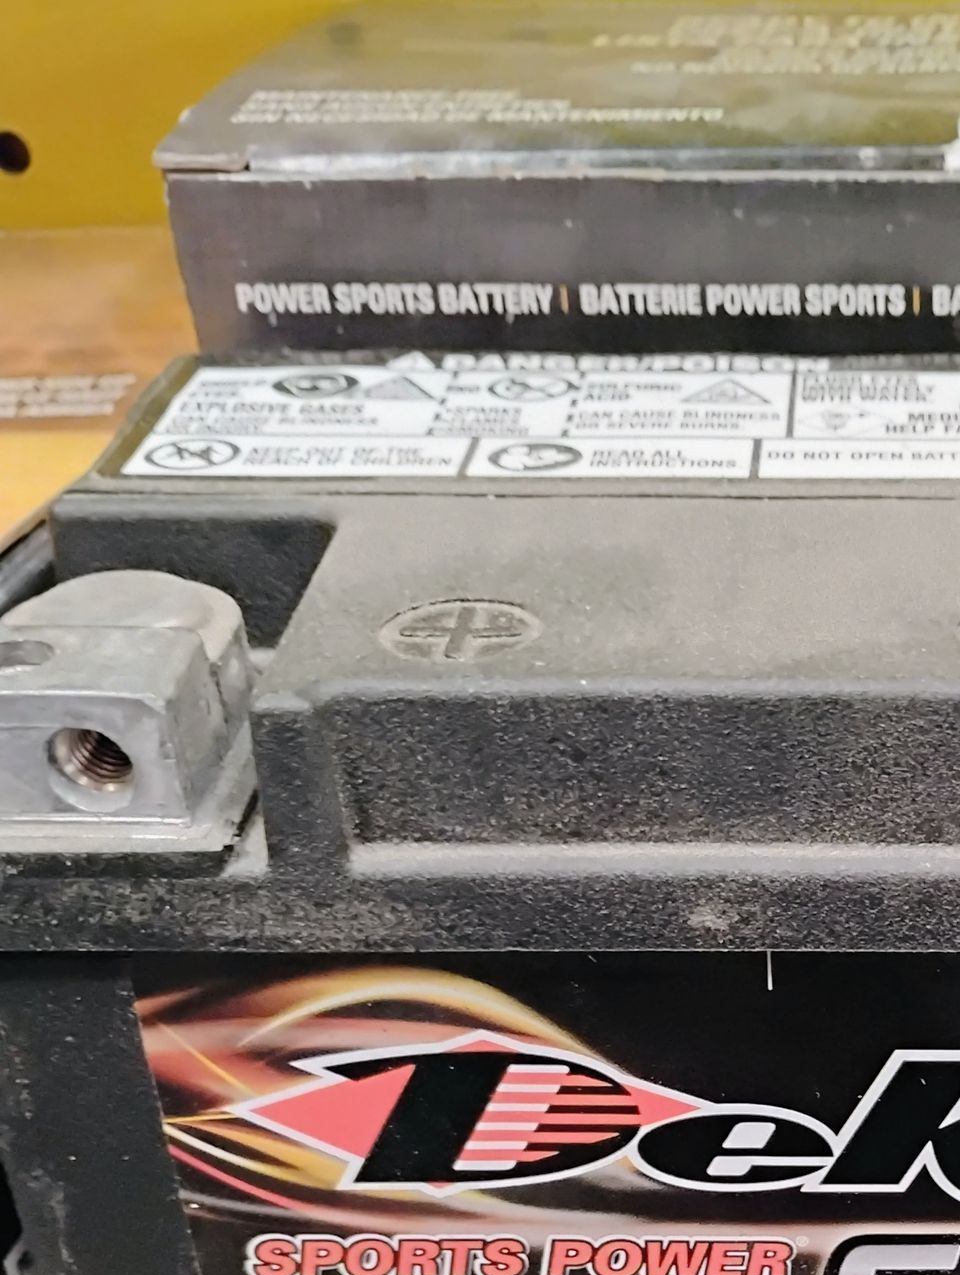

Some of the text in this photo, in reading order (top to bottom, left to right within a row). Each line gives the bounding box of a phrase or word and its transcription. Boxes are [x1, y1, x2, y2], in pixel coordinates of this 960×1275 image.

[235, 282, 553, 315] POWER SPORTS BATTERY
[579, 283, 906, 316] BATTERIE POWER SPORTS
[885, 424, 936, 434] HELP
[767, 451, 795, 460] DO
[803, 451, 842, 460] NOT
[849, 451, 903, 460] OPEN
